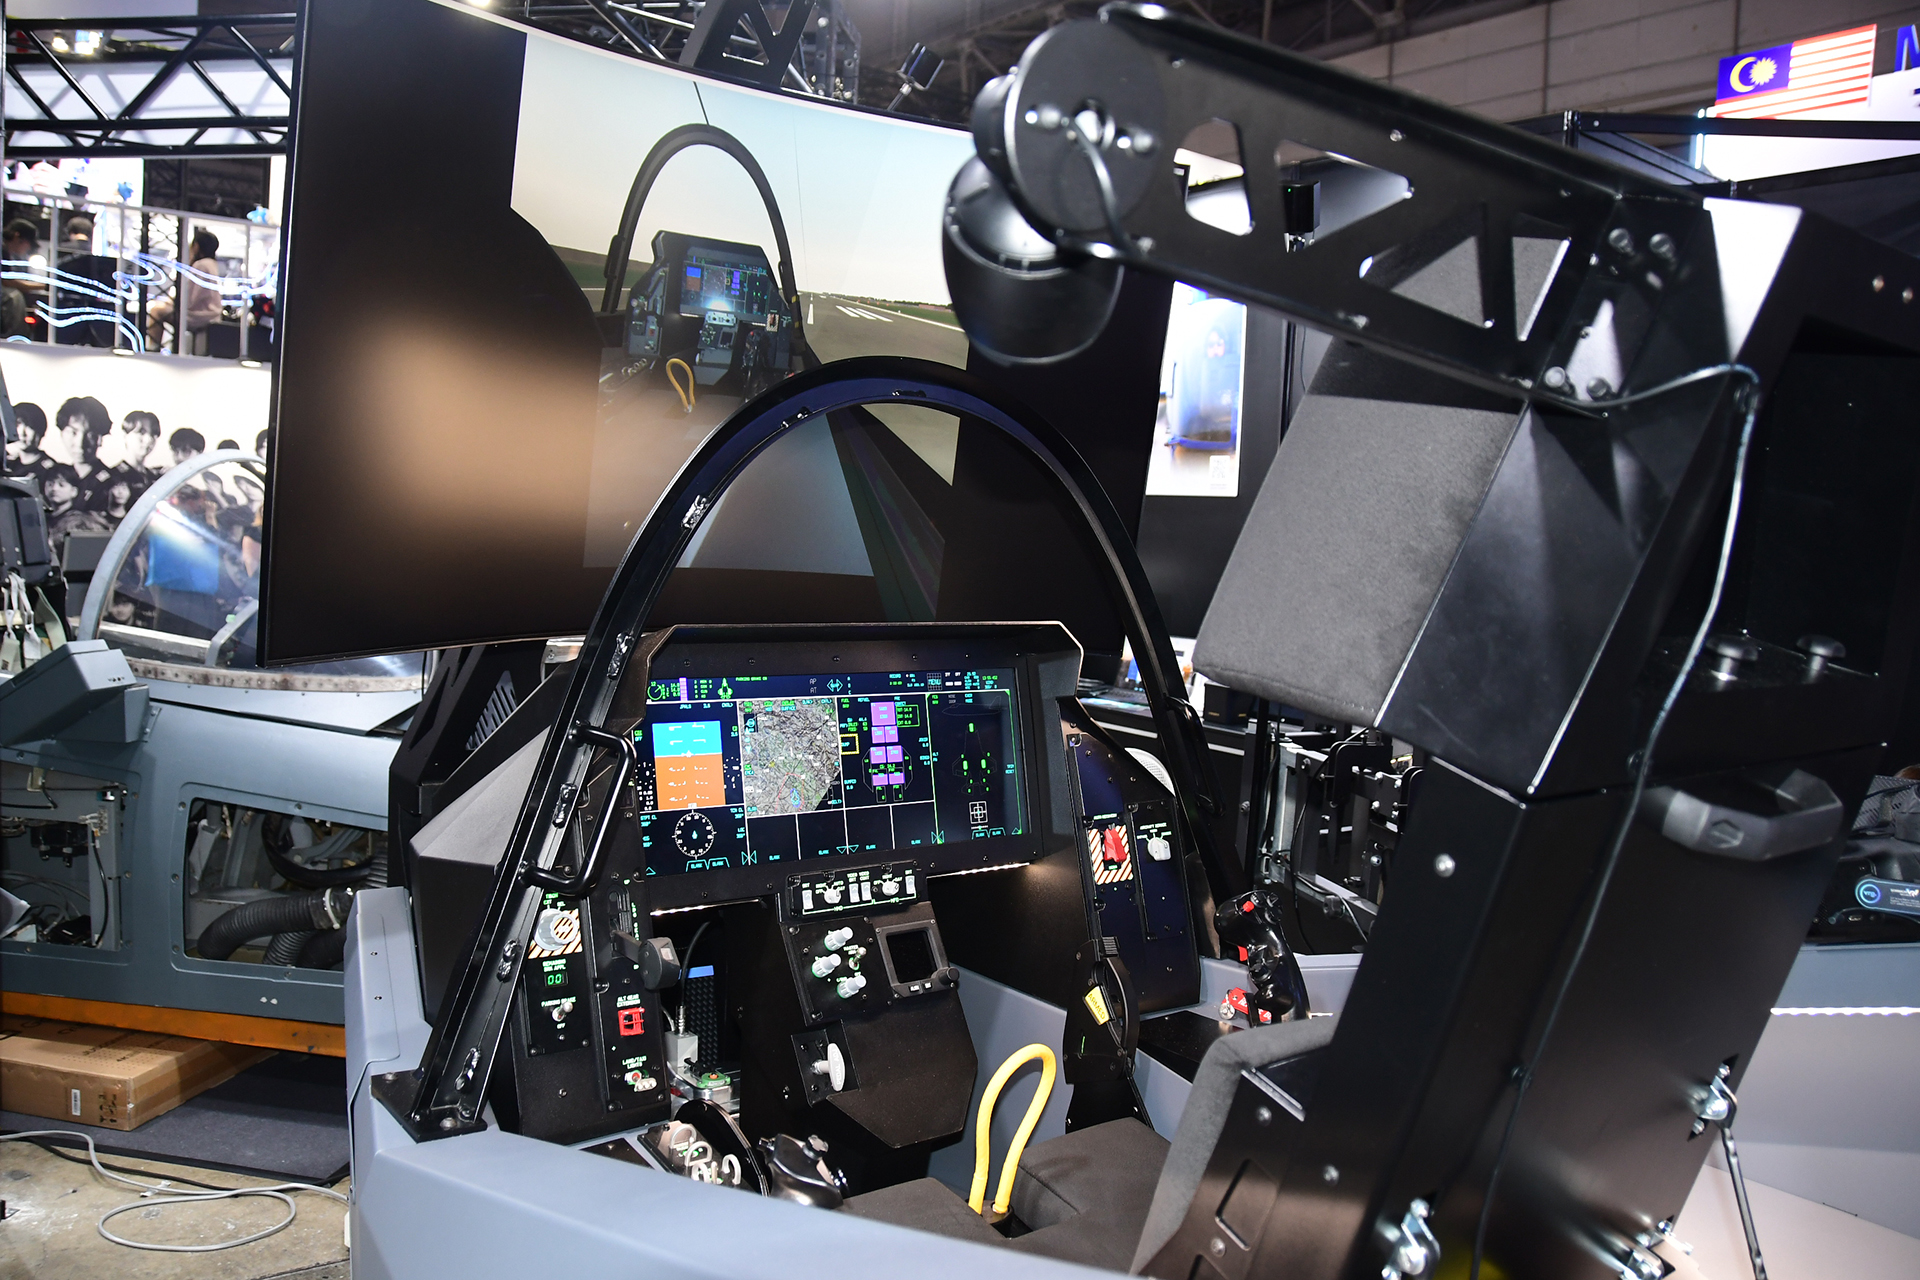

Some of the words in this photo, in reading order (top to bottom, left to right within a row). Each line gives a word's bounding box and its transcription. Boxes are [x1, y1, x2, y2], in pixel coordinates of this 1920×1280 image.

[928, 678, 942, 686] MENU
[547, 973, 563, 986] 00
[541, 998, 561, 1007] PARKING
[1087, 993, 1106, 1020] ARMED
